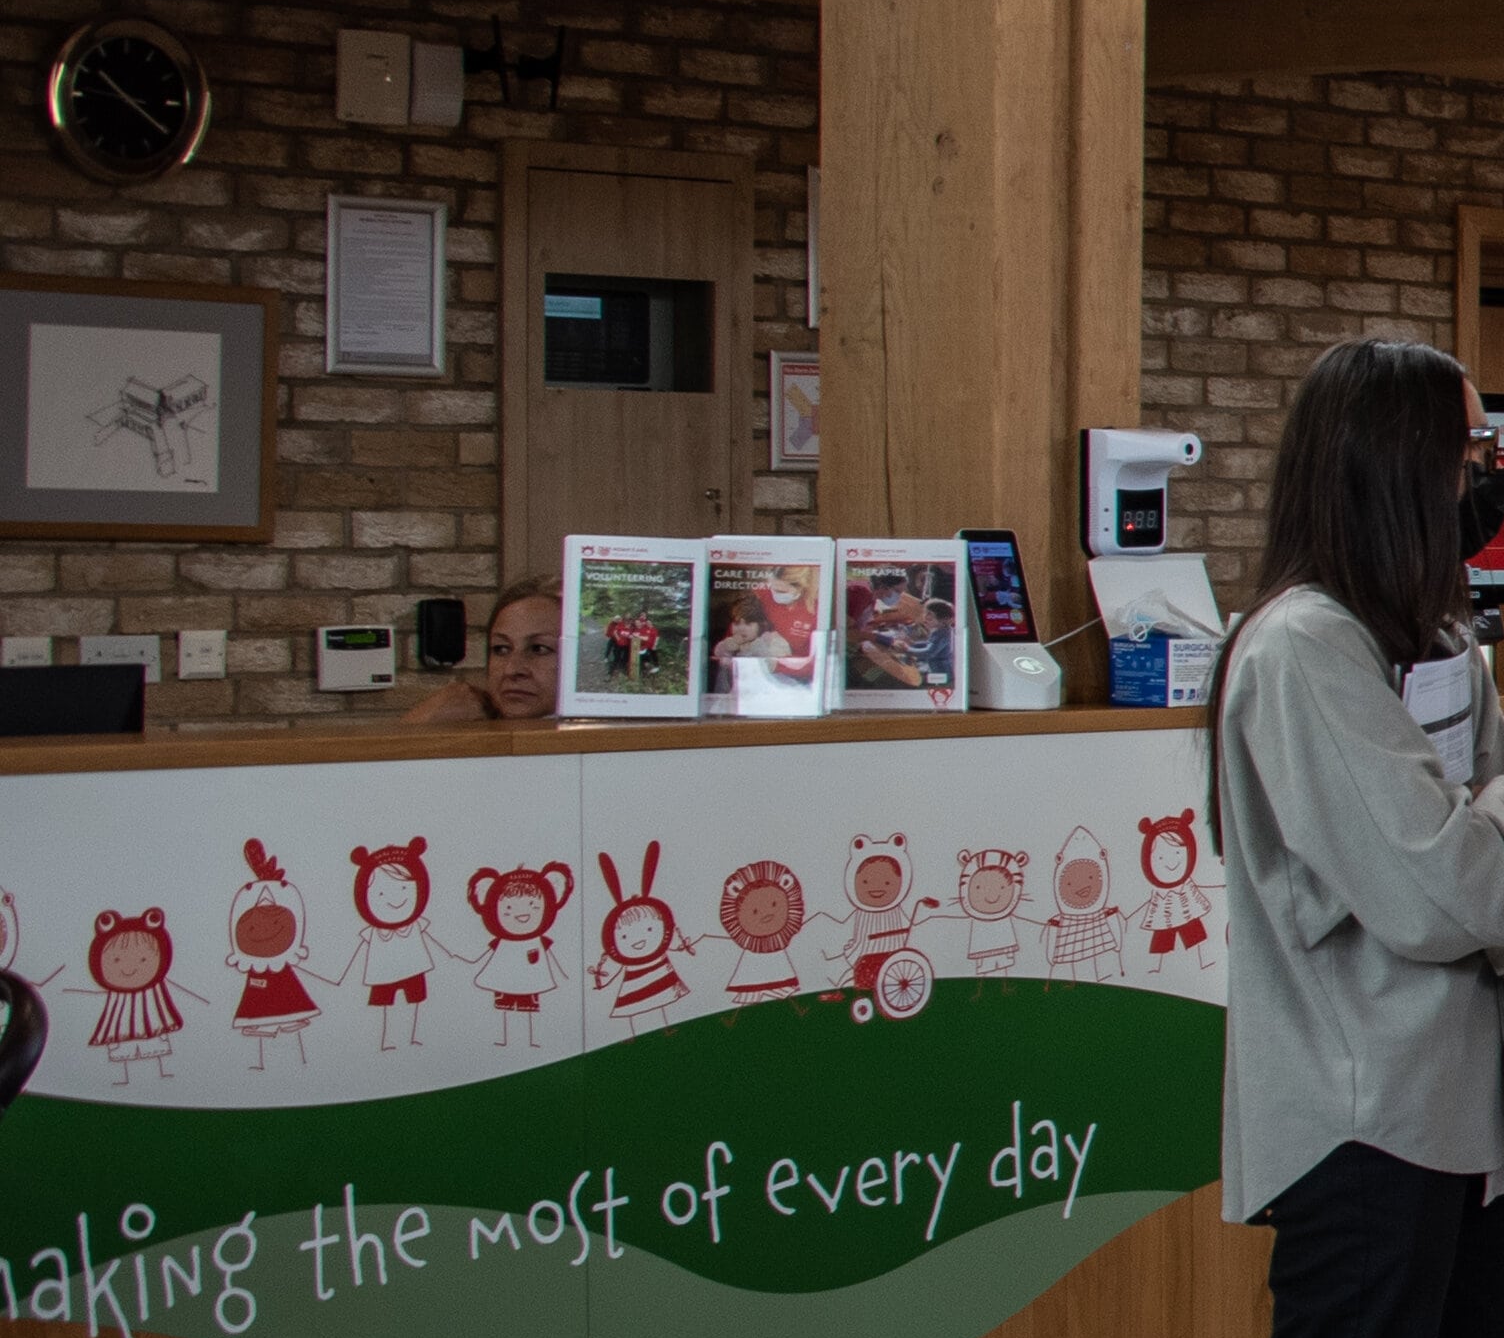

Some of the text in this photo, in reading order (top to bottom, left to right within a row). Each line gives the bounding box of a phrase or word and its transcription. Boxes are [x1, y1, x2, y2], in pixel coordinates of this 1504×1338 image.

[585, 572, 665, 584] VOLUNTEERING
[714, 568, 775, 580] CARE TEAM
[851, 567, 907, 578] THERAPIES
[714, 580, 773, 592] DIRECTORY
[1173, 644, 1215, 652] SURGICAL
[300, 1183, 430, 1301] the
[662, 1141, 732, 1243] of
[766, 1142, 961, 1241] every
[990, 1100, 1097, 1219] day
